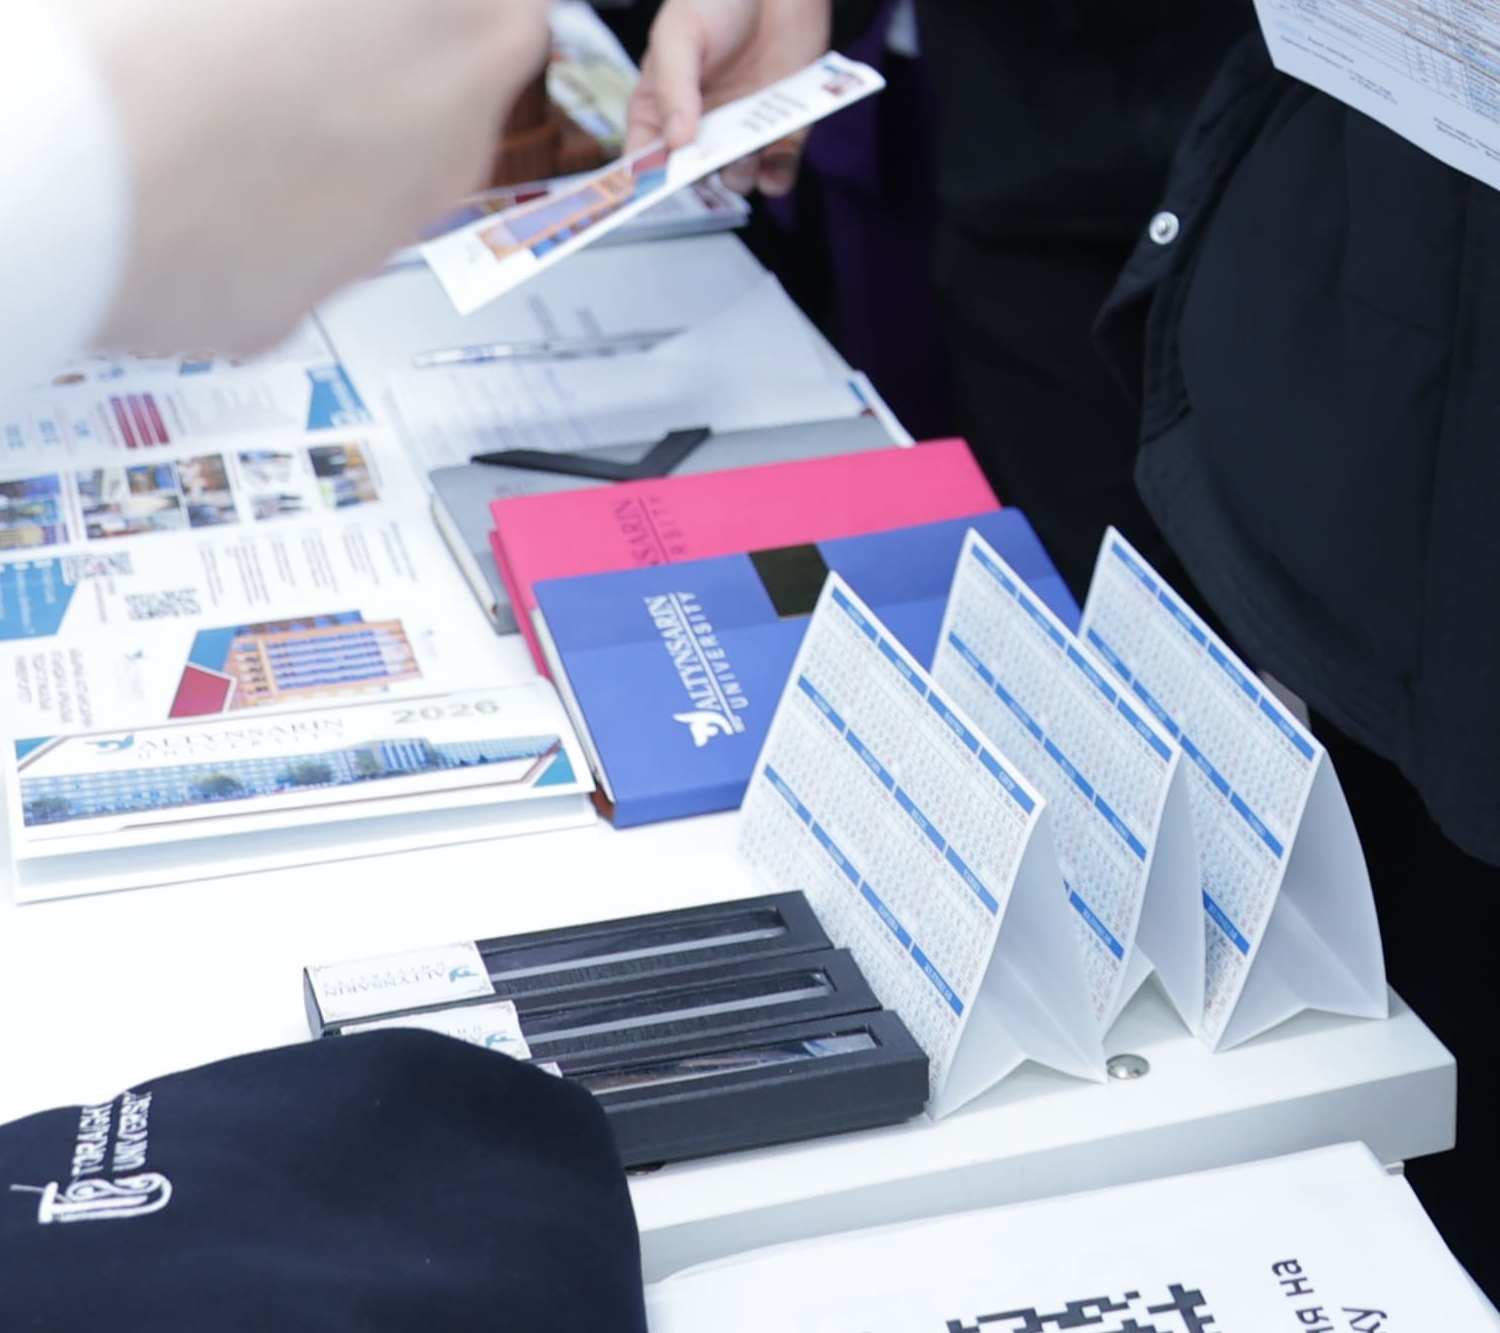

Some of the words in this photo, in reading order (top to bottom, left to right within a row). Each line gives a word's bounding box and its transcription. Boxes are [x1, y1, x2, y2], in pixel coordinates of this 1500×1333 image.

[643, 593, 724, 711] ALTYNSARIN
[675, 590, 750, 710] UNIVERSITY
[391, 698, 501, 725] 2026
[323, 967, 446, 998] ALTYNSARIN
[1271, 1258, 1315, 1297] на
